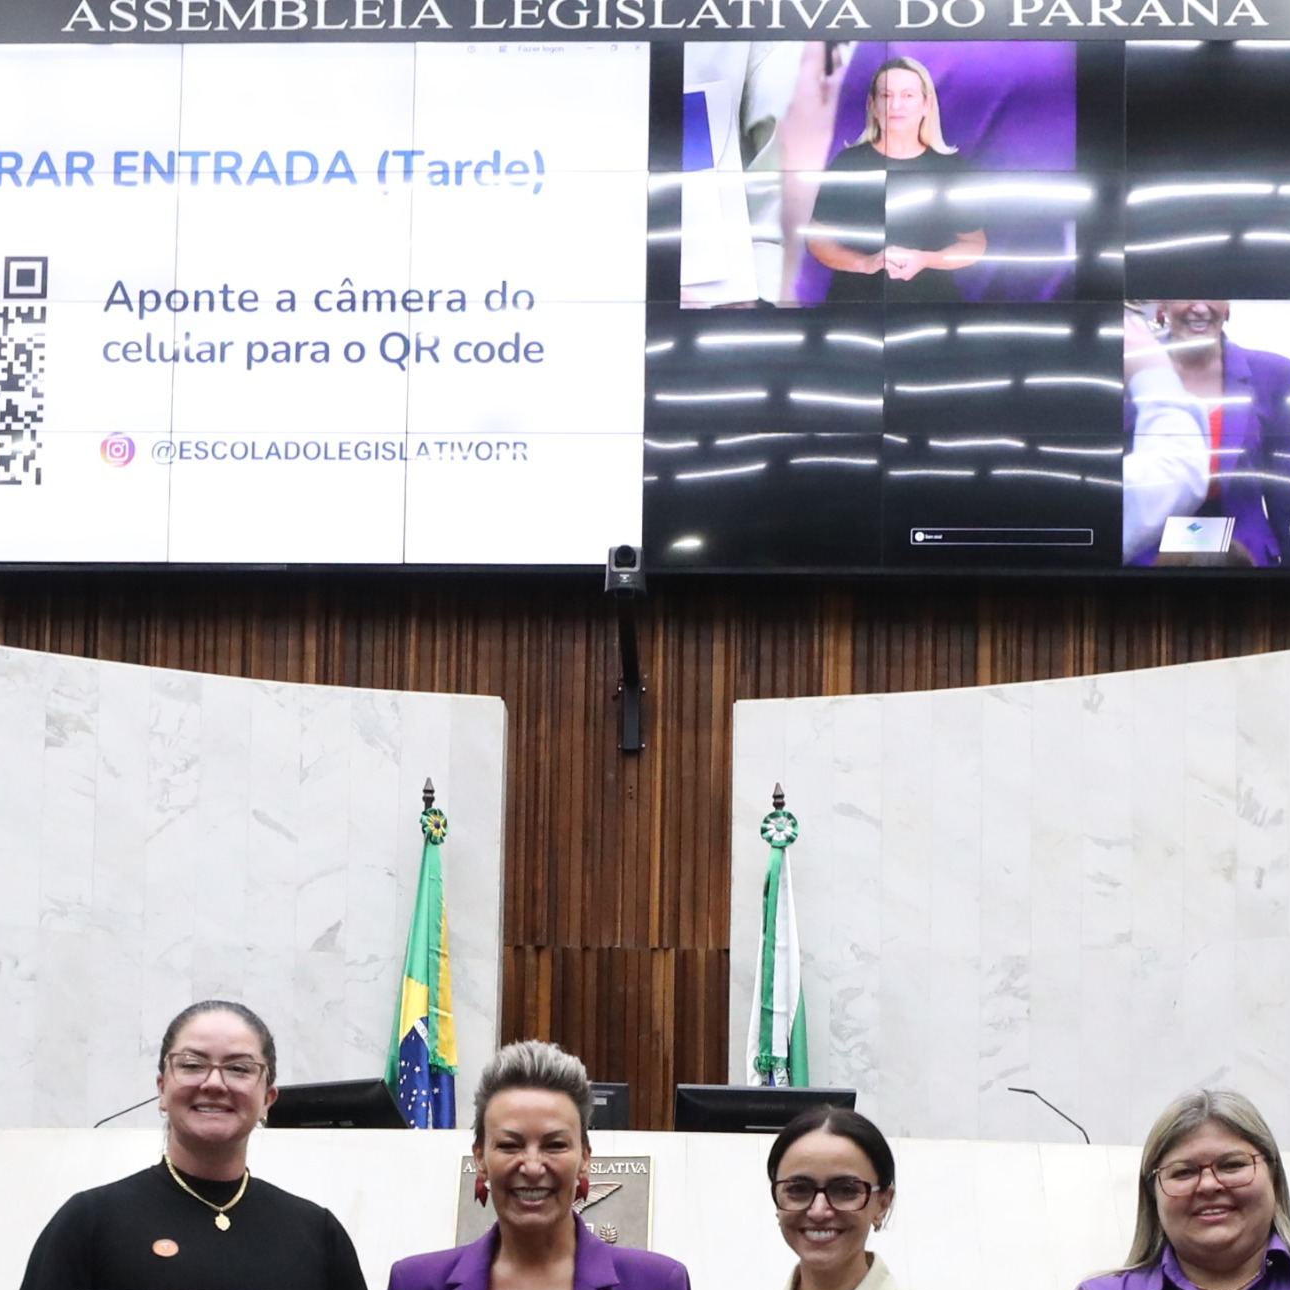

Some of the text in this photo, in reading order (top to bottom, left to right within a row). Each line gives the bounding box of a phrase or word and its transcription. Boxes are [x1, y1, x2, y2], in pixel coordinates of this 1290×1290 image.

[61, 0, 452, 33] ASSEMBLEIA
[470, 0, 871, 31] LEGISLATIVA
[895, 0, 987, 29] DO
[112, 150, 358, 187] ENTRADA
[376, 149, 546, 195] (Tarde)
[103, 277, 536, 320] Aponte a câmera do
[102, 330, 545, 372] celular para o QR code
[151, 439, 529, 466] @ESCOLADOLEGISLATIVOPR
